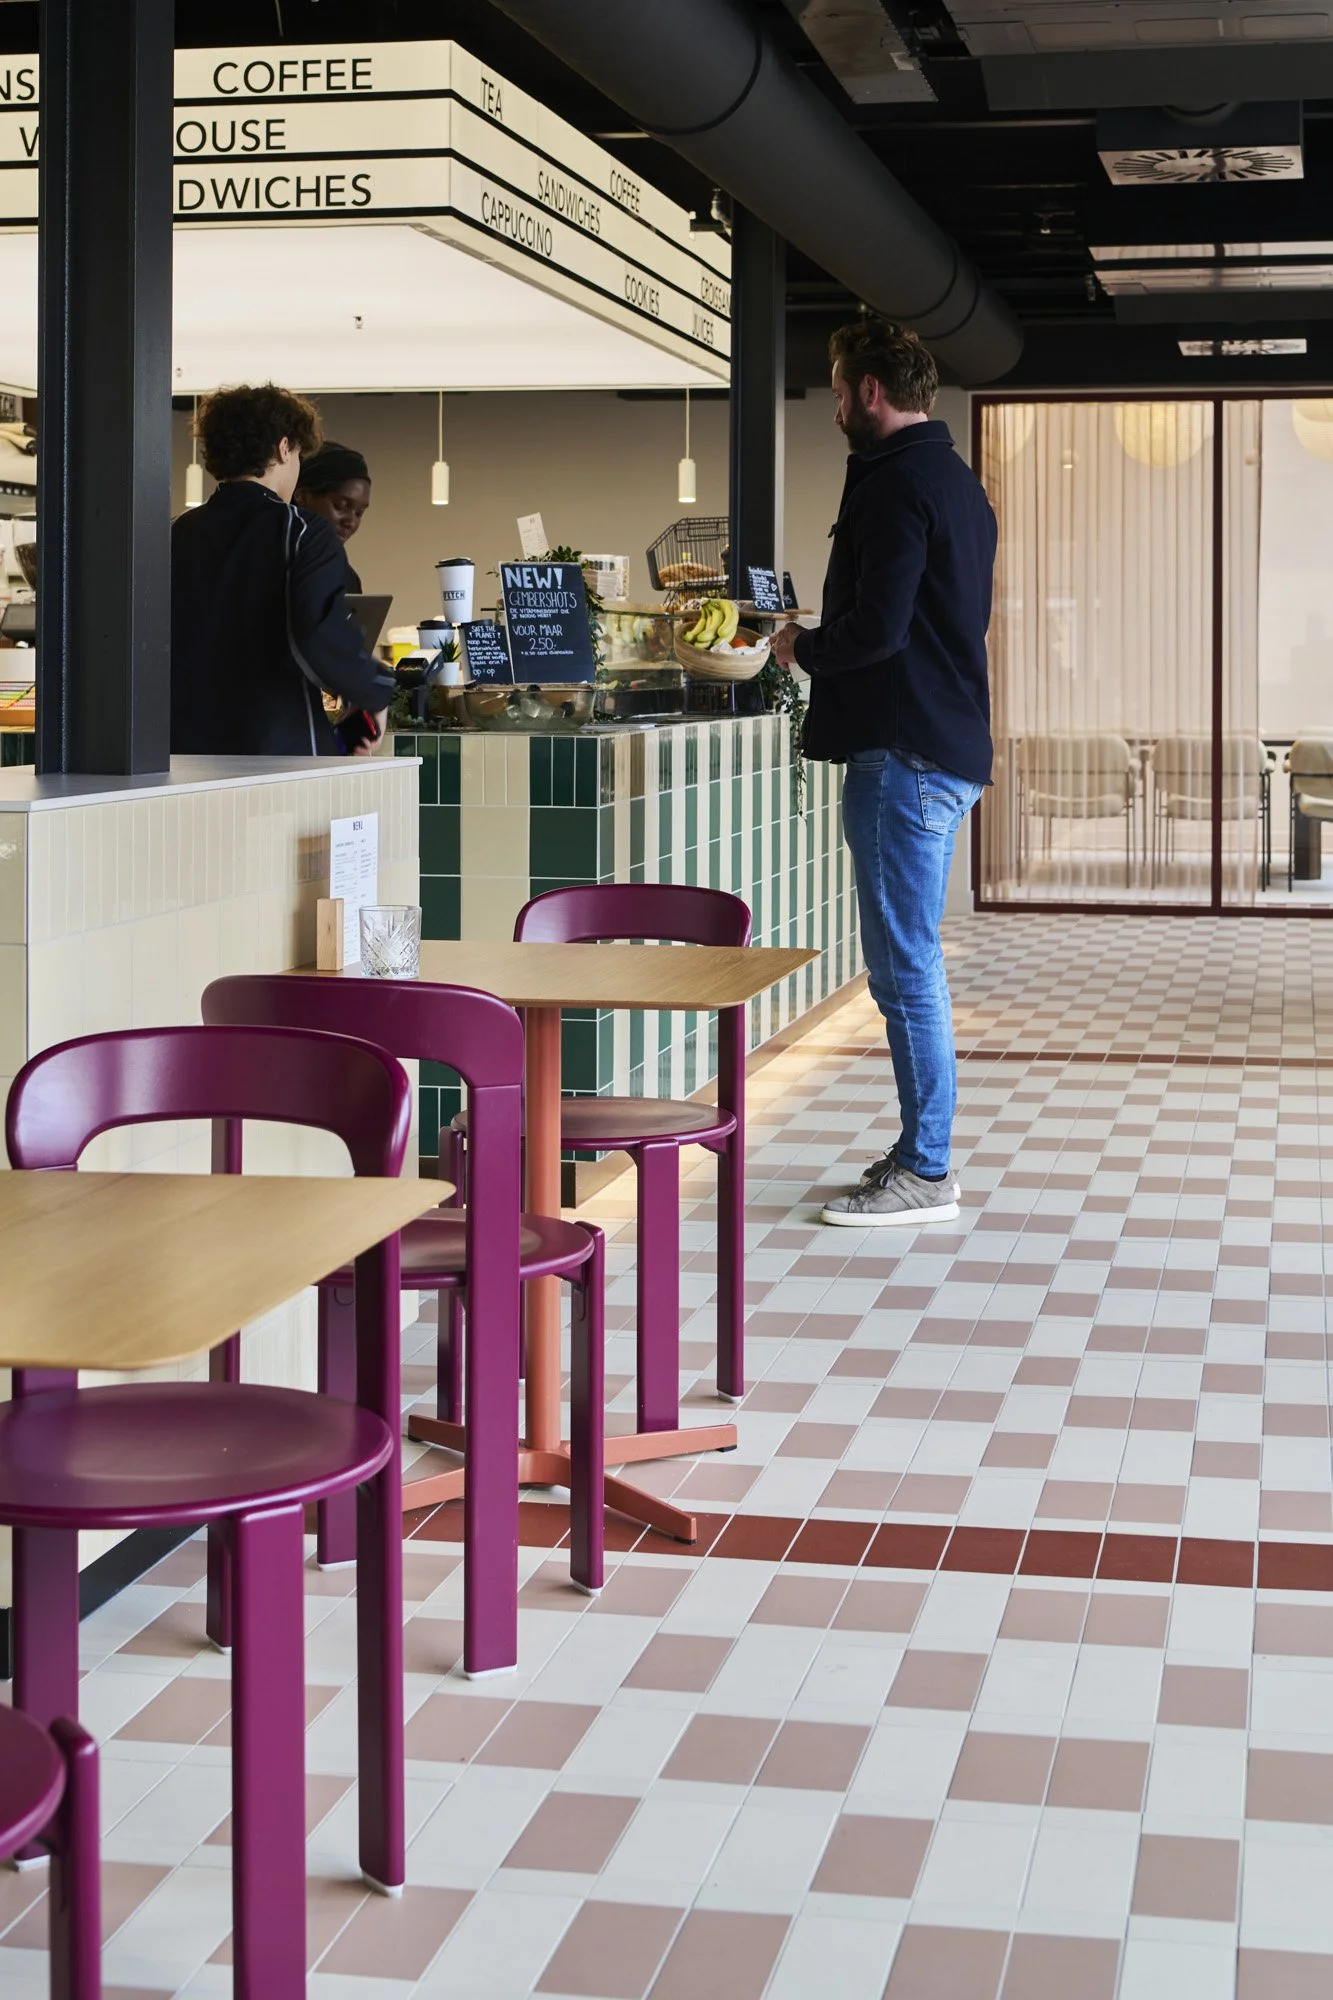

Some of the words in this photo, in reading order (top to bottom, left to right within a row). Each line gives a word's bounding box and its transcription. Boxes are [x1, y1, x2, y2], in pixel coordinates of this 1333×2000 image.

[213, 58, 373, 94] COFFEE
[481, 77, 503, 120] TEA
[538, 171, 600, 235] SANDWICHES
[609, 169, 640, 214] COFFEE
[481, 191, 553, 257] CAPPUCCINO
[625, 274, 659, 316] COOKIES
[692, 313, 714, 345] JUICES
[504, 567, 563, 589] NEW!
[539, 624, 563, 637] MAAR
